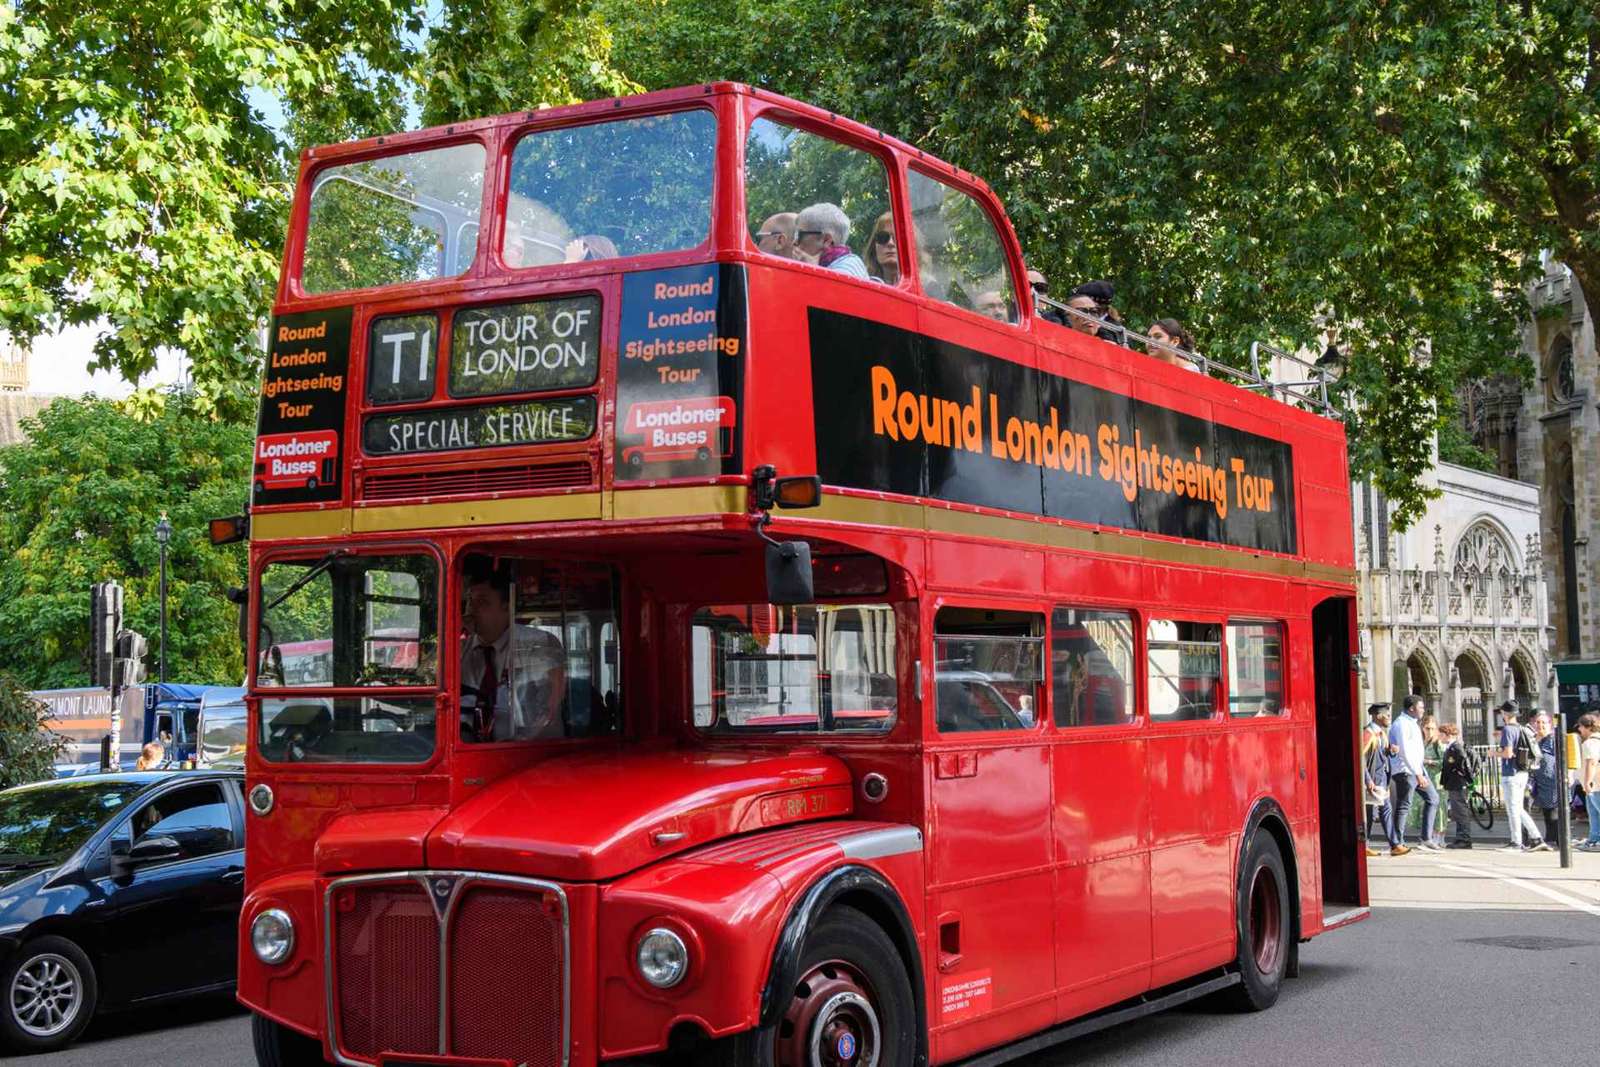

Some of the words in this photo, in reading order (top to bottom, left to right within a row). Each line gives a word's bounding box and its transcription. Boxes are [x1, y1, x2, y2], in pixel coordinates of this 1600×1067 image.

[654, 277, 714, 300] Round
[648, 307, 716, 328] London
[279, 321, 326, 342] Round
[464, 316, 537, 347] TOUR
[553, 310, 591, 336] OF
[272, 349, 326, 368] London
[463, 342, 587, 376] LONDON
[625, 337, 739, 361] Sightseeing
[262, 374, 343, 397] ightseeing
[658, 366, 701, 385] Tour
[278, 401, 313, 420] Tour
[636, 406, 725, 427] Londoner
[389, 419, 475, 452] SPECIAL
[486, 408, 574, 440] SERVICE
[652, 429, 709, 449] Buses
[259, 437, 331, 457] Londoner
[871, 366, 984, 453] Round
[990, 393, 1091, 479] London
[1098, 423, 1227, 519] Sightseeing
[1231, 458, 1274, 512] Tour
[272, 459, 317, 476] Buses
